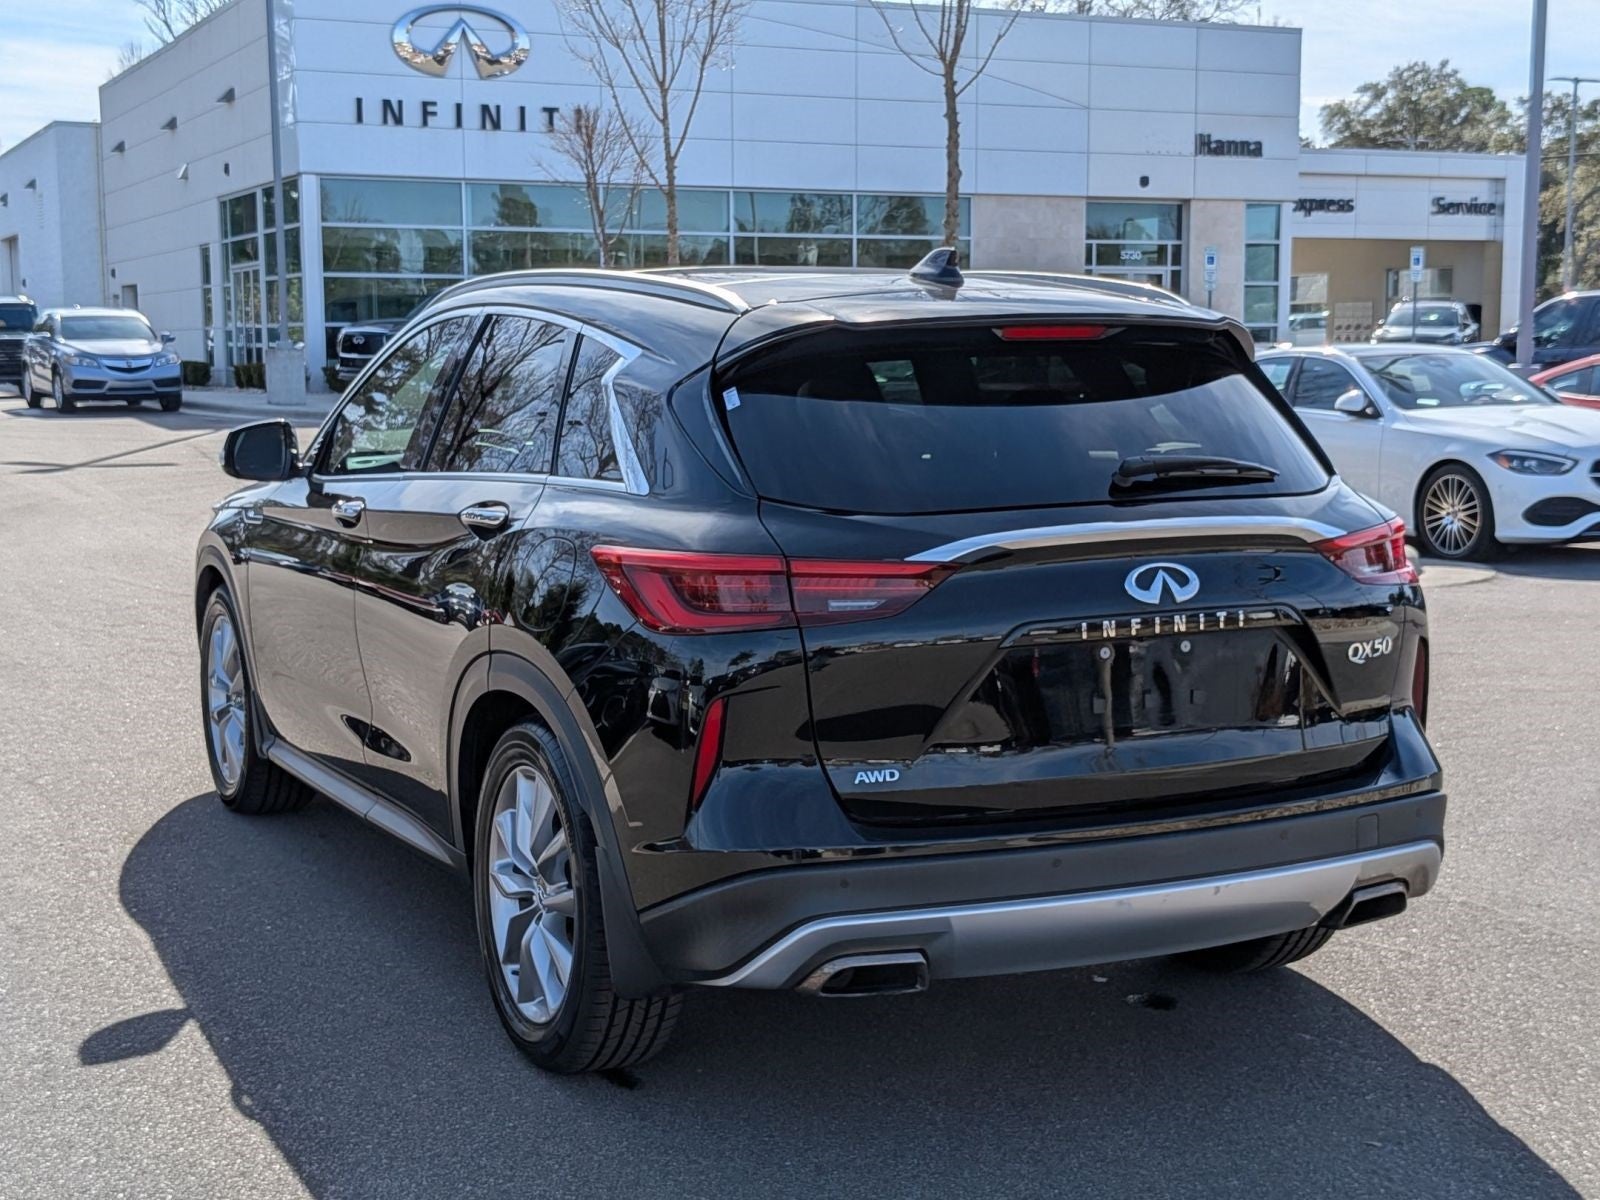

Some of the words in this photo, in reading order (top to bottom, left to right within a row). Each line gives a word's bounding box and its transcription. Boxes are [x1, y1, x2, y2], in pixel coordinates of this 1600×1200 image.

[1195, 133, 1263, 157] Hanna
[1292, 198, 1355, 217] xpress
[1431, 196, 1498, 216] Service
[1080, 609, 1245, 640] INFINITI
[1347, 635, 1393, 665] QX50
[854, 768, 900, 785] AWD
